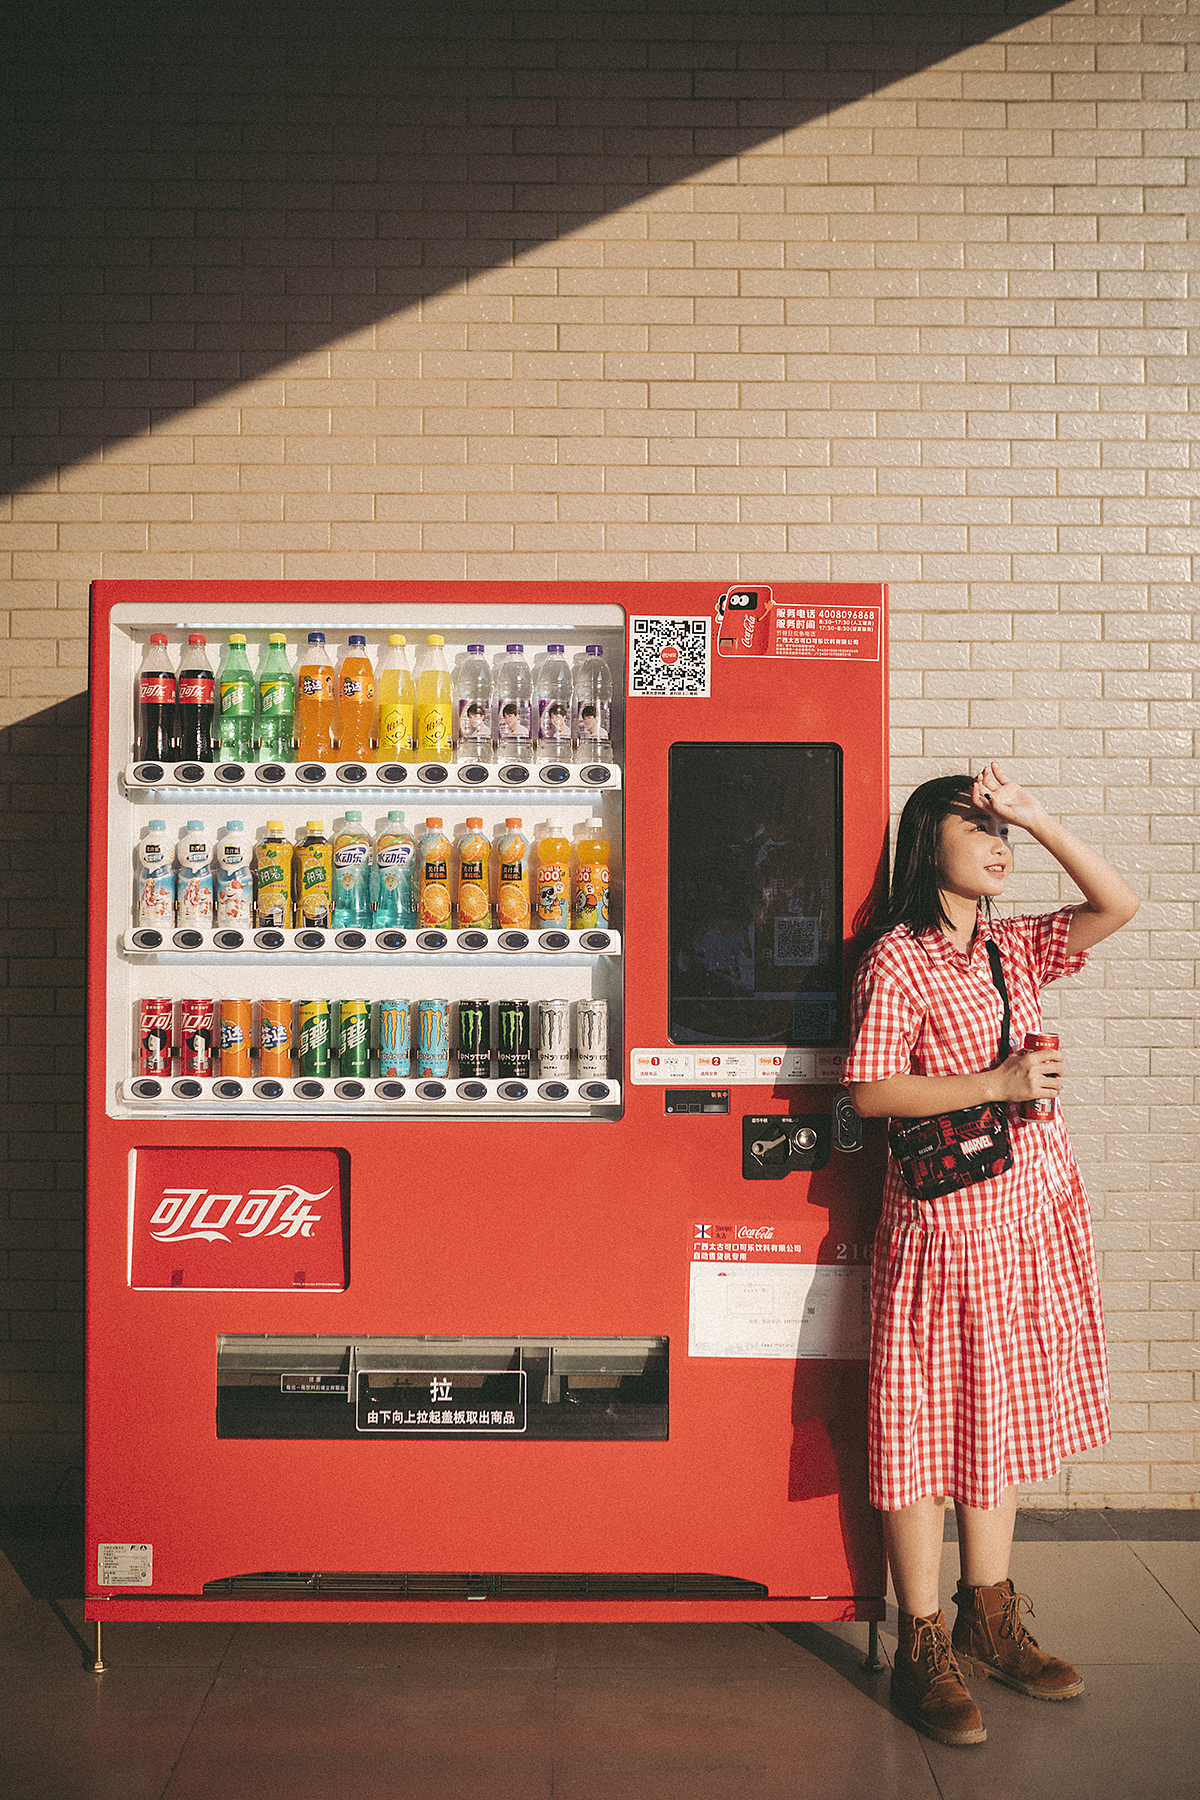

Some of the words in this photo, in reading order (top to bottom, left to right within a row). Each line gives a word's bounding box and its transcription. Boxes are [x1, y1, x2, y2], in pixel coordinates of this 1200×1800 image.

[776, 608, 816, 618] 服务电话
[818, 609, 875, 620] 4008096868
[776, 619, 816, 629] 服务时间
[222, 686, 246, 713] 雪碧
[263, 686, 287, 713] 雪碧
[260, 867, 280, 882] 阳光
[306, 866, 325, 885] 阳光
[140, 1012, 173, 1031] 口可
[182, 1012, 214, 1031] 口可
[261, 1023, 289, 1046] 芬达
[461, 1053, 488, 1061] ONSTE
[500, 1053, 528, 1061] ONSTE
[638, 1057, 650, 1065] Step
[699, 1057, 711, 1065] Step
[760, 1057, 772, 1065] Step
[961, 1136, 992, 1155] MARVEL
[150, 1184, 334, 1243] 可口可乐
[693, 1242, 802, 1253] 广西太古可口可乐饮料有限公司
[693, 1252, 747, 1261] 自动售货机专用
[430, 1377, 453, 1403] 拉
[367, 1410, 515, 1425] 由下向上拉起盖板取出商品
